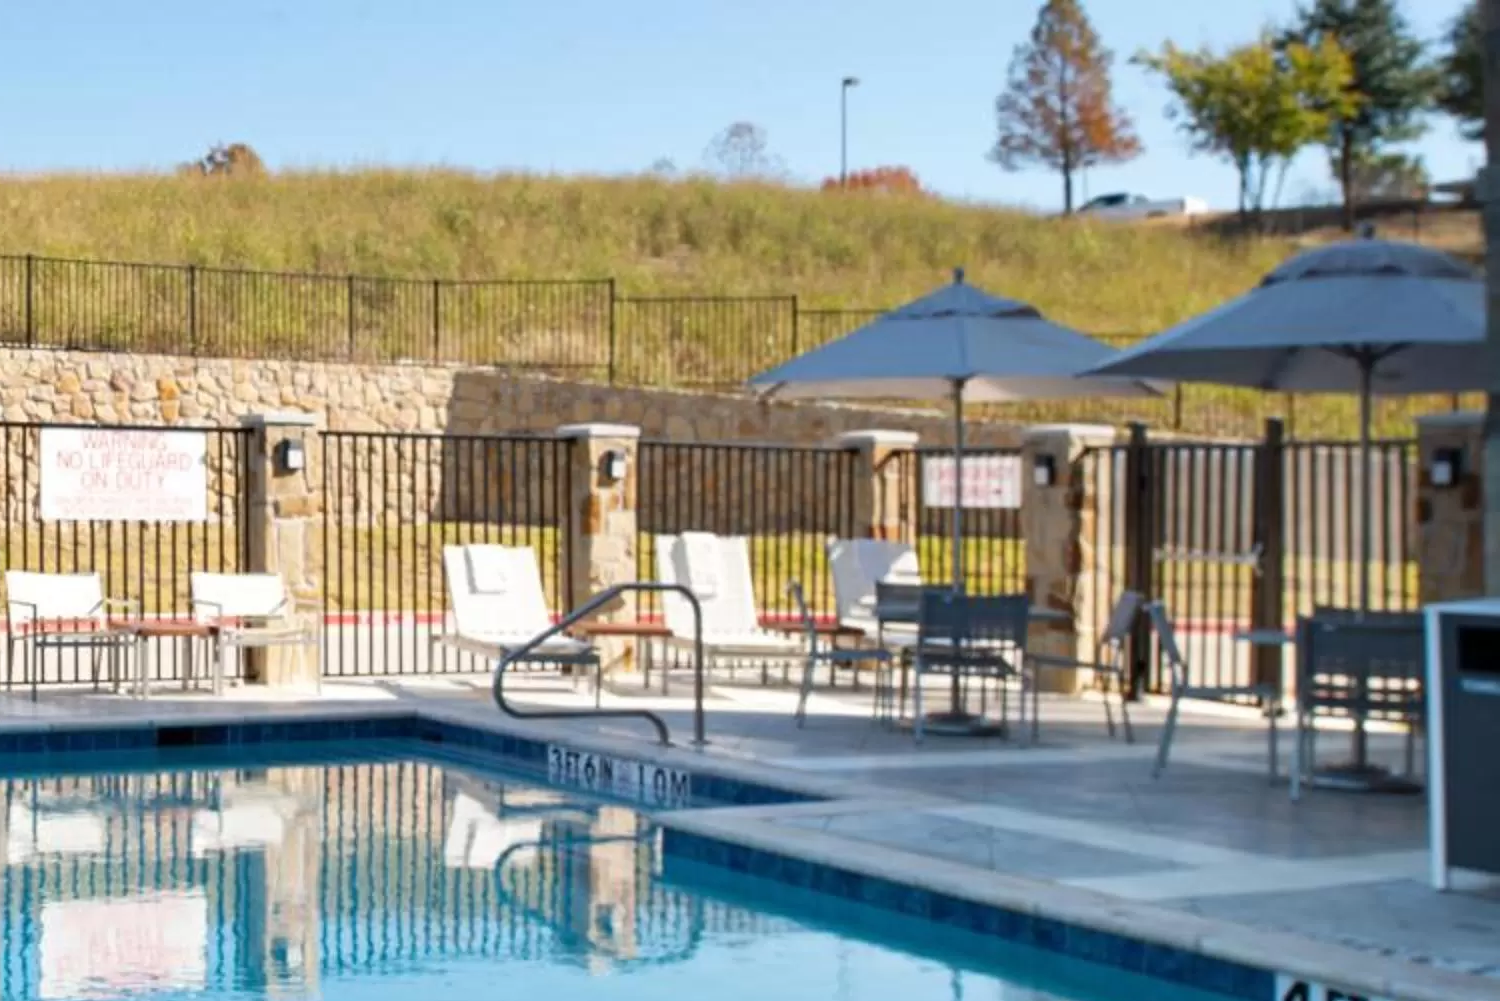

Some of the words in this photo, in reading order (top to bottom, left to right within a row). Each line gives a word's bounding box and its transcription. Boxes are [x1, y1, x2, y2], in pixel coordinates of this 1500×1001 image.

[56, 450, 84, 469] NO
[89, 451, 194, 472] LIFEGUARD
[81, 471, 108, 488] ON
[116, 472, 165, 490] DUTY
